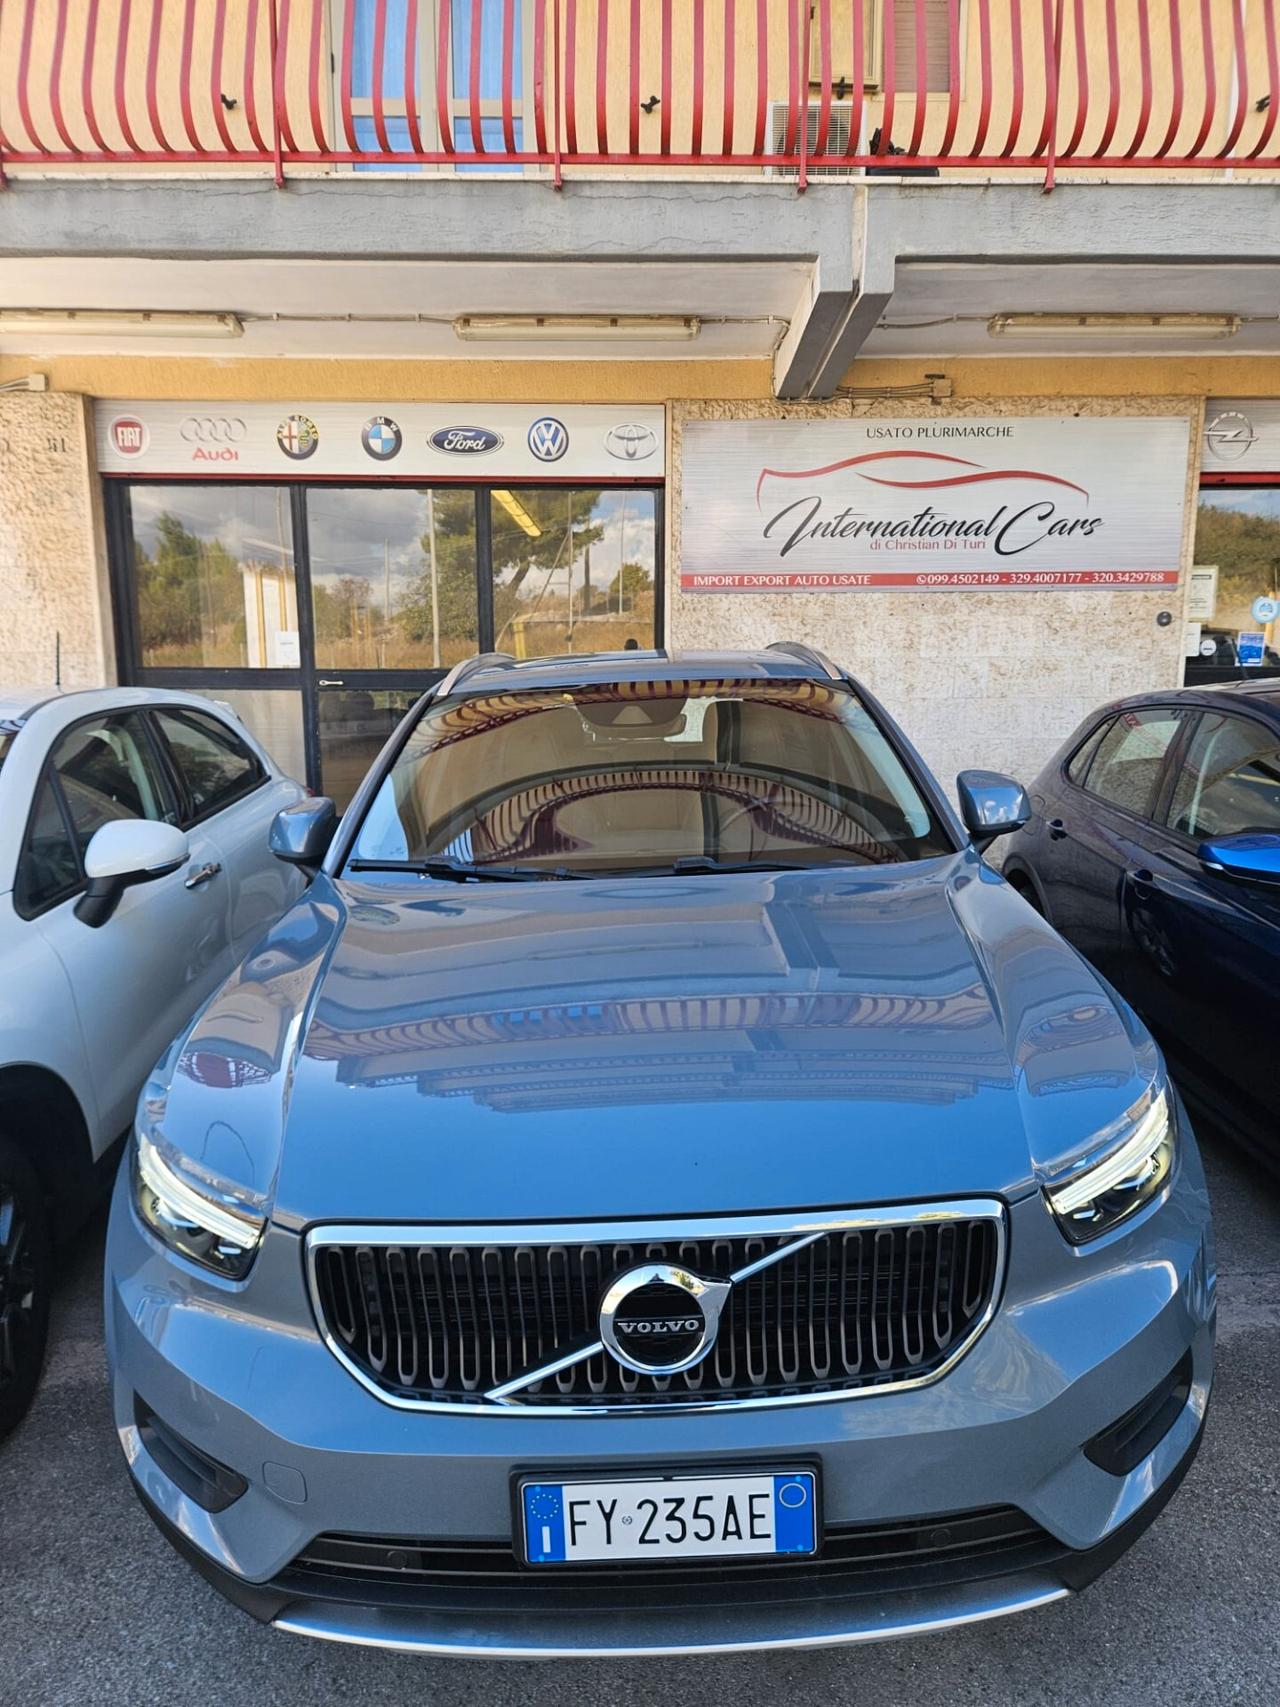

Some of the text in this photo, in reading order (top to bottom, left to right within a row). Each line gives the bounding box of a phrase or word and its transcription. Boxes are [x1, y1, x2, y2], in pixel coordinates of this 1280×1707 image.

[116, 426, 141, 447] FIAT
[866, 426, 1015, 439] USATO PLURIMARCHE
[443, 431, 486, 451] Ford
[192, 447, 239, 461] Audi
[763, 496, 1104, 557] International Cars
[869, 538, 987, 551] di Christian Di Turi
[694, 574, 872, 587] IMPORT EXPORT AUTO USATE
[927, 574, 1000, 585] 099.4502149
[1009, 573, 1082, 584] 329.4007177
[1092, 572, 1165, 583] 320.3429788
[617, 1319, 700, 1334] VOLVO
[568, 1498, 618, 1546] FY
[636, 1493, 772, 1545] 235AE
